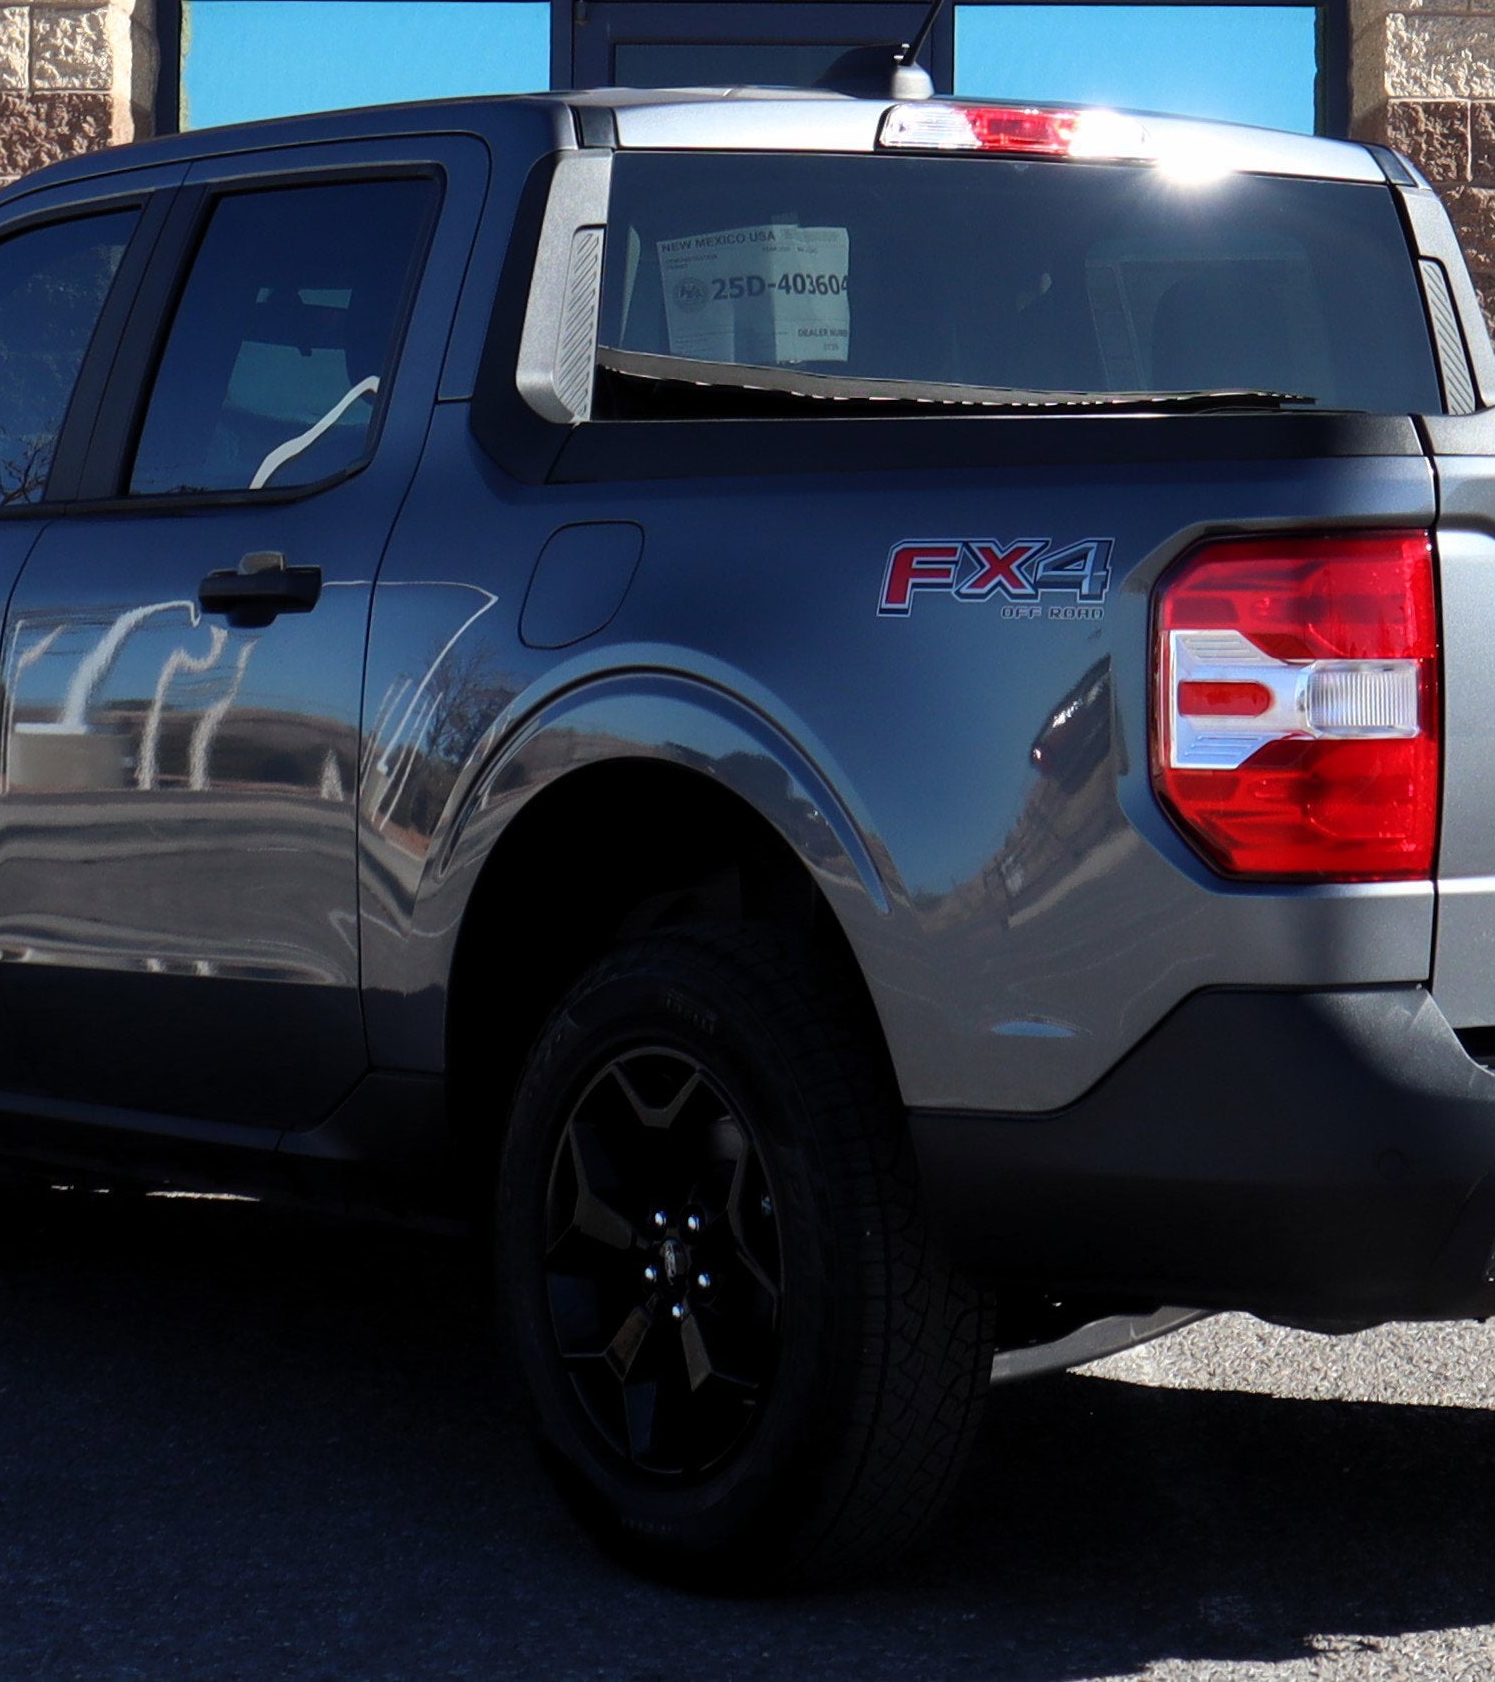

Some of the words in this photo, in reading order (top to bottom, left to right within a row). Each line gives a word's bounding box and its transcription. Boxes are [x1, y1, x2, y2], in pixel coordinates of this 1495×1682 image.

[661, 240, 692, 253] NEW
[695, 233, 746, 249] MEXICO
[749, 230, 776, 243] USA
[877, 537, 1115, 618] FX4
[1001, 605, 1042, 620] OFF
[1048, 605, 1105, 620] ROAD
